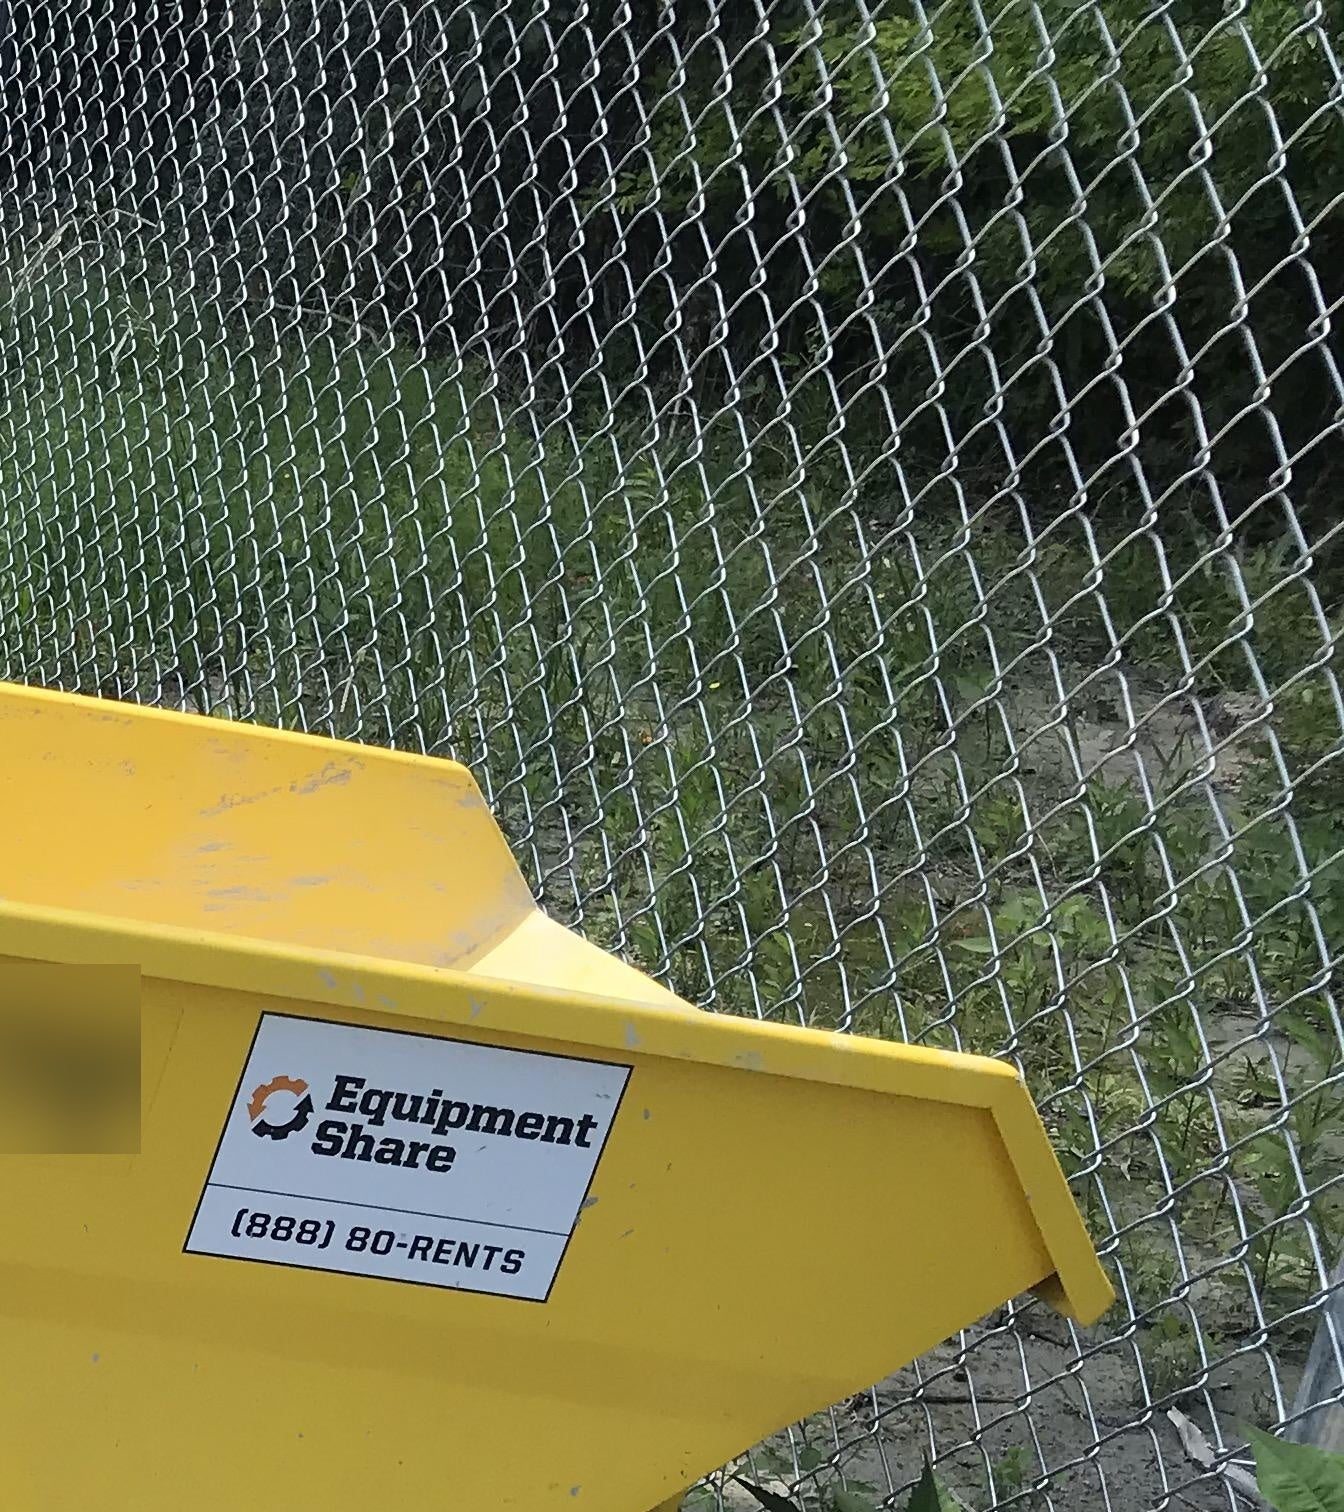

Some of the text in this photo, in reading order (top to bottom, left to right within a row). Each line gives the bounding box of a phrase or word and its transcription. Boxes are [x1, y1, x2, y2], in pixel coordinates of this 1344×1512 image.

[324, 1074, 599, 1149] Equipment
[312, 1119, 456, 1173] Share
[230, 1207, 525, 1275] (888) 80-RENTS
